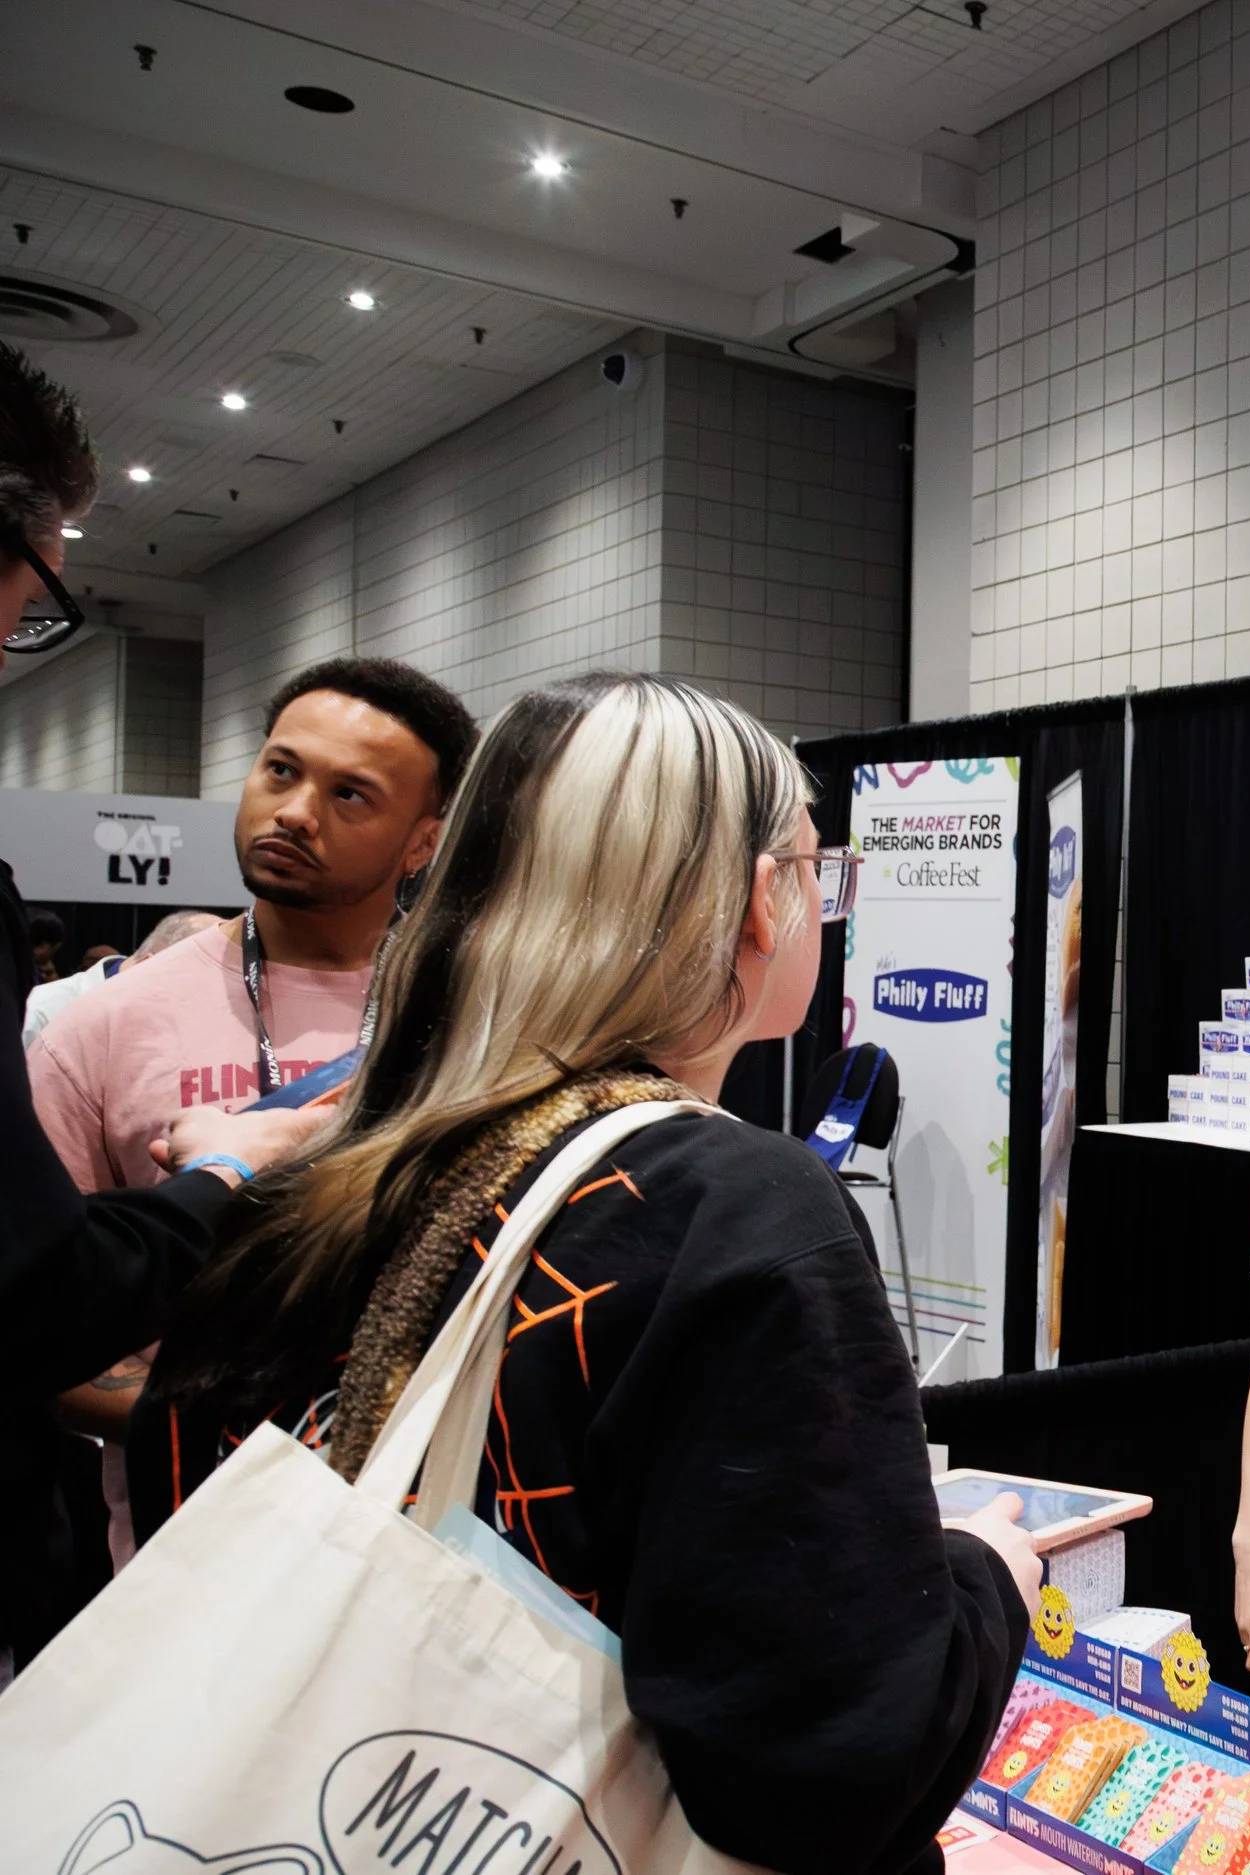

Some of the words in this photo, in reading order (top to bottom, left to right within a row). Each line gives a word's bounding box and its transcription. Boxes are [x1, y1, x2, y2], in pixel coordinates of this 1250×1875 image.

[871, 817, 898, 833] THE
[902, 815, 966, 832] MARKET
[969, 814, 1001, 831] FOR
[863, 834, 934, 852] EMERGING
[939, 833, 1003, 851] BRANDS
[108, 854, 170, 886] LY!
[877, 977, 928, 1012] Philly
[934, 981, 985, 1010] Fluff
[1040, 1823, 1067, 1851] MOUTH
[1067, 1836, 1105, 1873] WATERING
